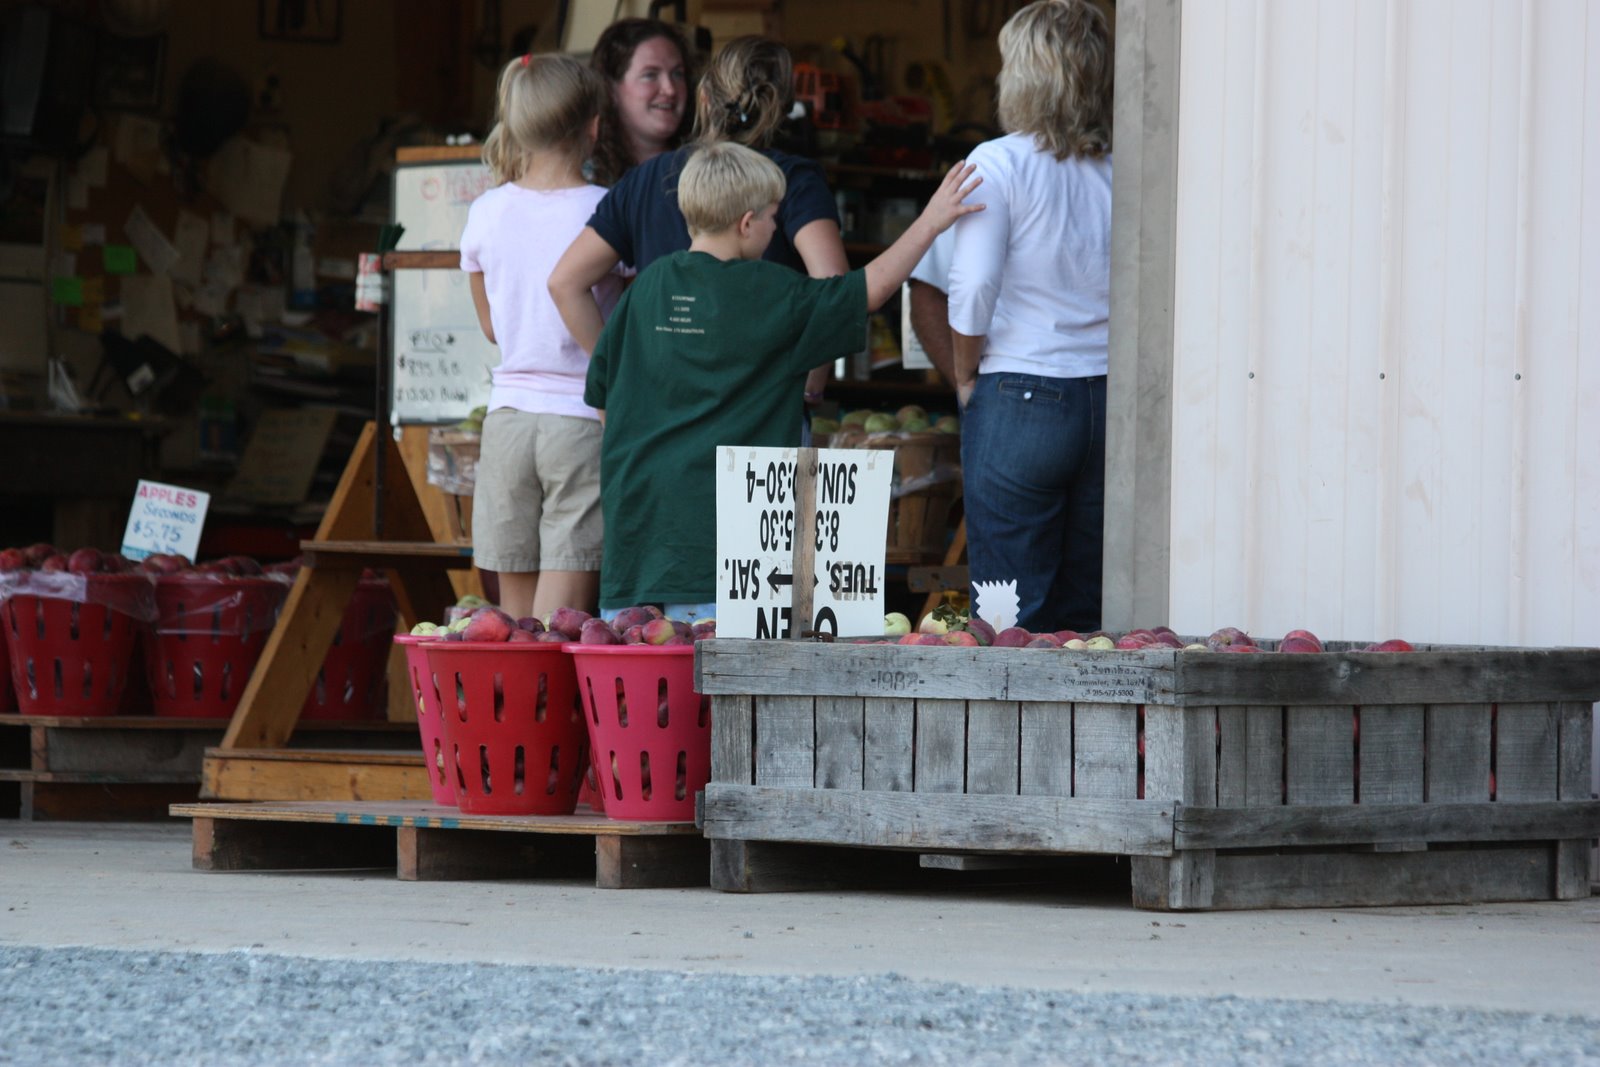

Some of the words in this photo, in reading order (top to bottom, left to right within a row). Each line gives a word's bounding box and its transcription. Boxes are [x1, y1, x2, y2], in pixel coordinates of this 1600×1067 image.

[139, 485, 197, 508] APPLES
[818, 462, 858, 505] SUN.
[133, 520, 183, 543] $5.75
[724, 558, 761, 600] SAT.
[826, 560, 878, 594] TUES.
[756, 606, 838, 640] OEN
